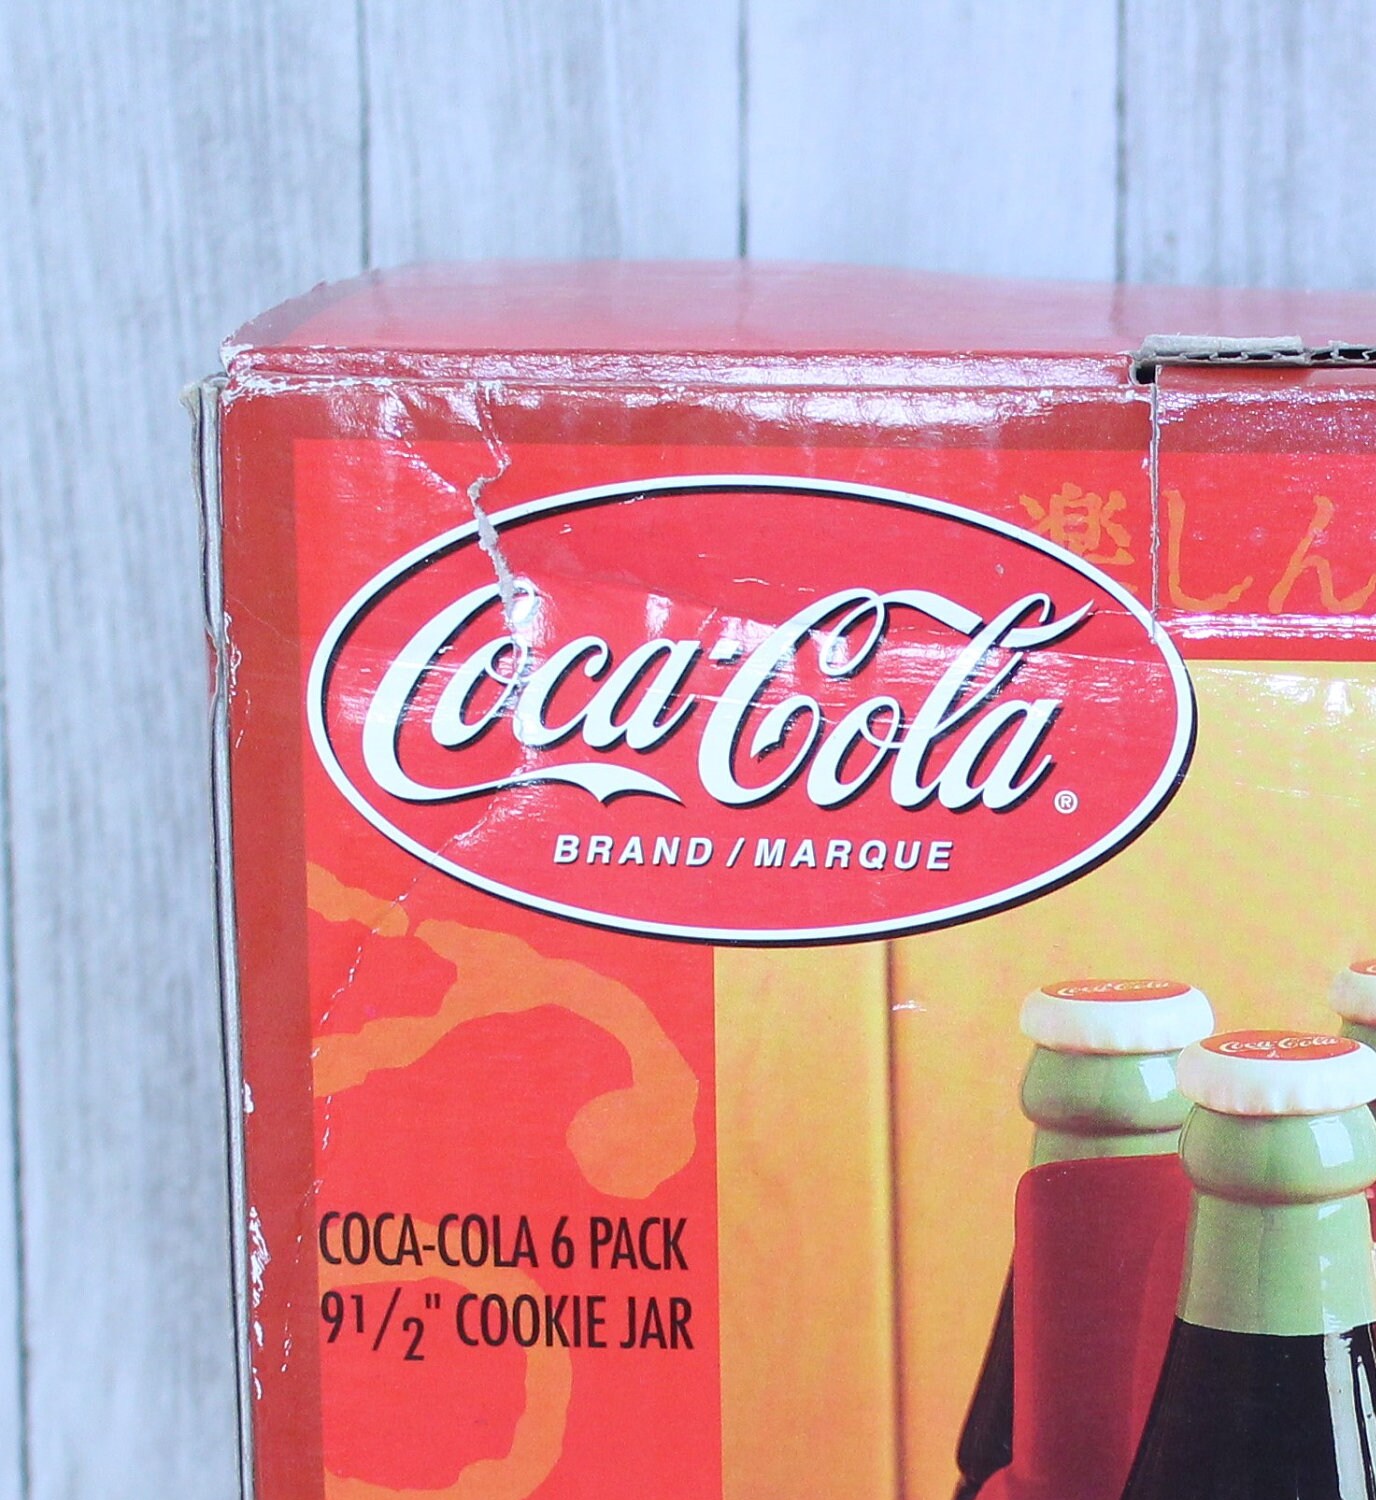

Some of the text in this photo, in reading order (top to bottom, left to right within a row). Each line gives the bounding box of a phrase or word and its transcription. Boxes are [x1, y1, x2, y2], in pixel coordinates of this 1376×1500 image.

[361, 584, 1097, 814] Coca-Cola
[1218, 1035, 1340, 1053] Coca-Cola
[318, 1211, 690, 1271] COCA-COLA 6 PACK
[455, 1292, 608, 1350] COOKIE
[619, 1296, 695, 1351] JAR
